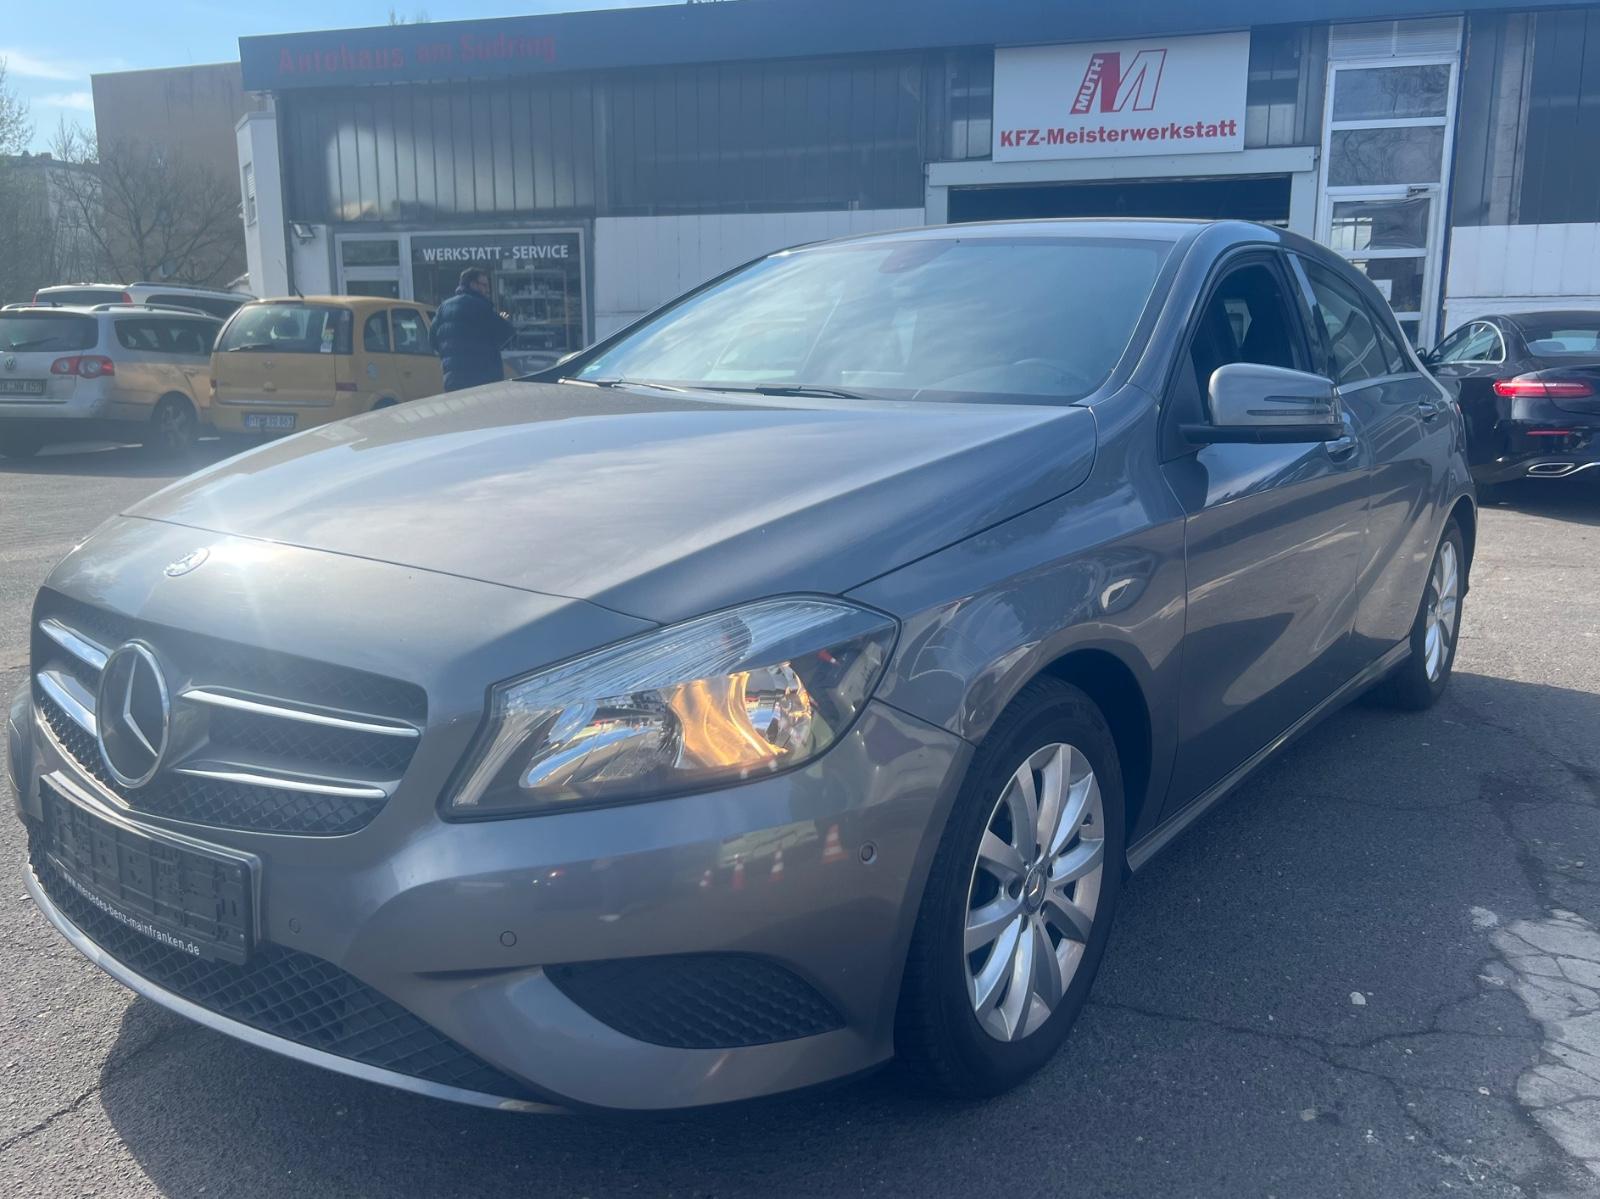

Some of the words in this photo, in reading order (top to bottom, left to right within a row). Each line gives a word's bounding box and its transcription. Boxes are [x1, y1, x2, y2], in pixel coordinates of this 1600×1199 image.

[279, 44, 405, 74] Autohaus
[417, 45, 452, 64] am
[1075, 58, 1104, 111] MUTH
[1000, 120, 1237, 148] KFZ-Meisterwerkstatt
[423, 246, 501, 261] WERKSTATT
[512, 244, 569, 260] SERVICE
[63, 871, 200, 956] www.mercedes-benz-mainfranken.de
